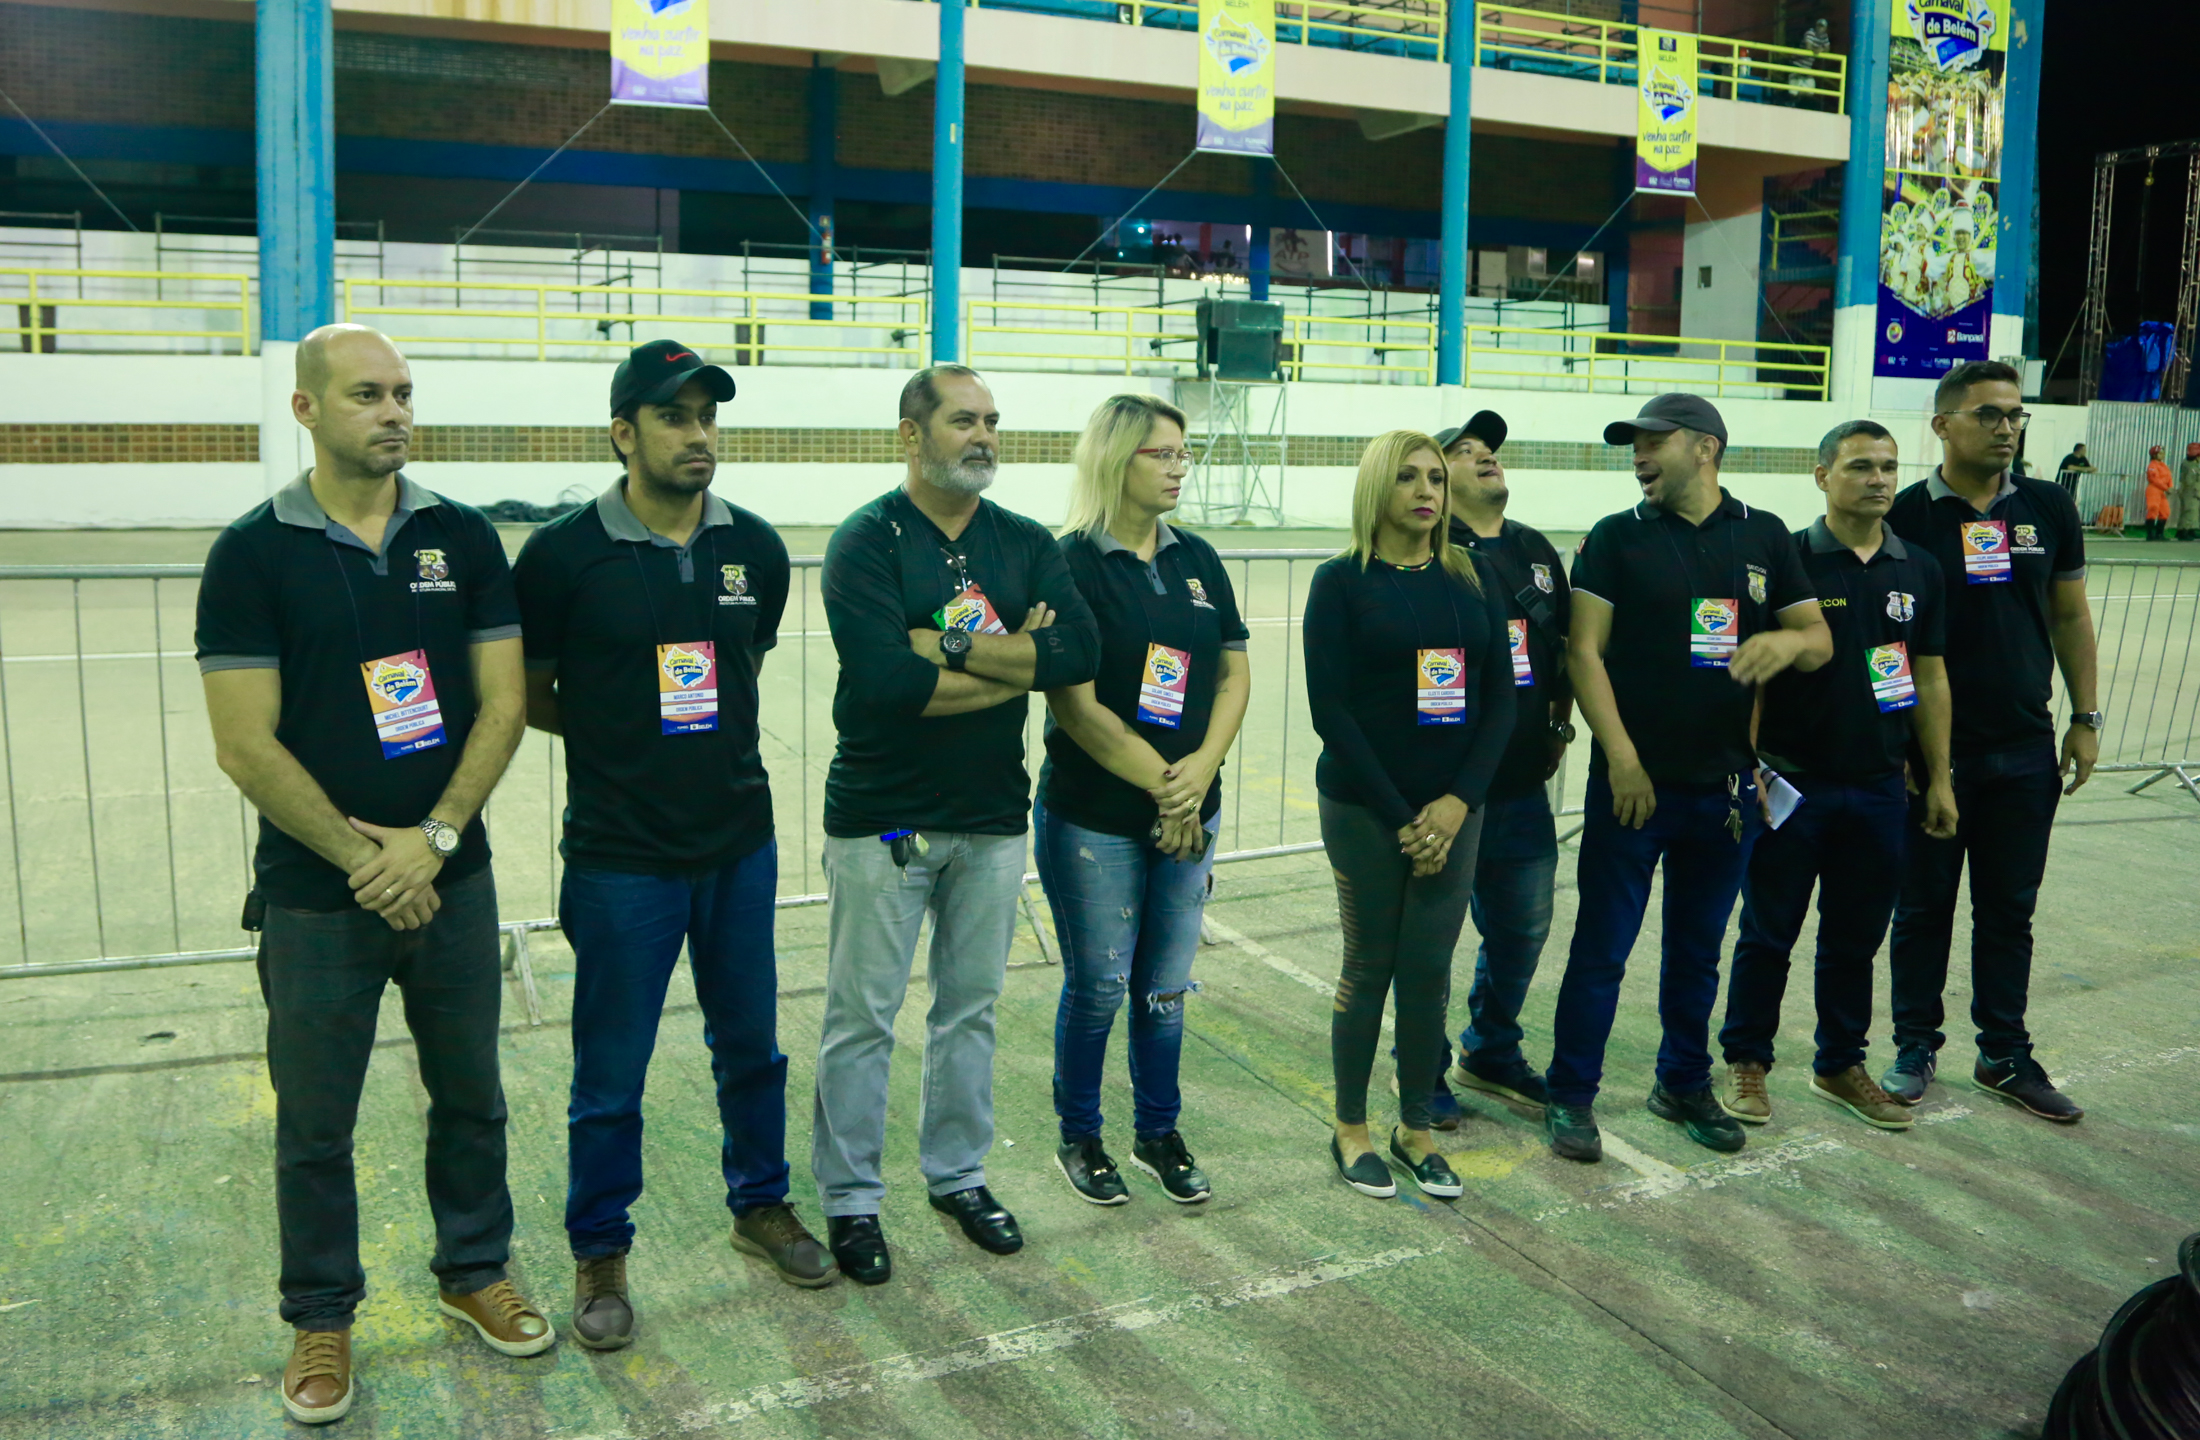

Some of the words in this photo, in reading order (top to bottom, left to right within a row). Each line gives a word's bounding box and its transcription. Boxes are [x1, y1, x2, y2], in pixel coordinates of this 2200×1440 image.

[1919, 0, 1964, 14] Carnaval
[622, 21, 659, 40] venha
[664, 25, 702, 44] curtir
[1214, 29, 1246, 38] Carnaval
[1926, 18, 1940, 34] de
[1943, 18, 1976, 42] Belém
[639, 45, 654, 56] na
[1206, 80, 1236, 97] venha
[1239, 84, 1268, 100] curtir
[1220, 101, 1231, 110] na
[1643, 127, 1667, 141] venha
[1670, 129, 1692, 144] curtir
[1654, 145, 1663, 154] na
[1746, 564, 1766, 575] SECON
[1819, 598, 1846, 607] ECON
[950, 607, 969, 624] Carnaval
[963, 611, 980, 622] Belém
[378, 670, 406, 682] Carnaval
[386, 683, 395, 692] de
[395, 679, 416, 688] Belém
[400, 705, 429, 716] BITTENCOURT
